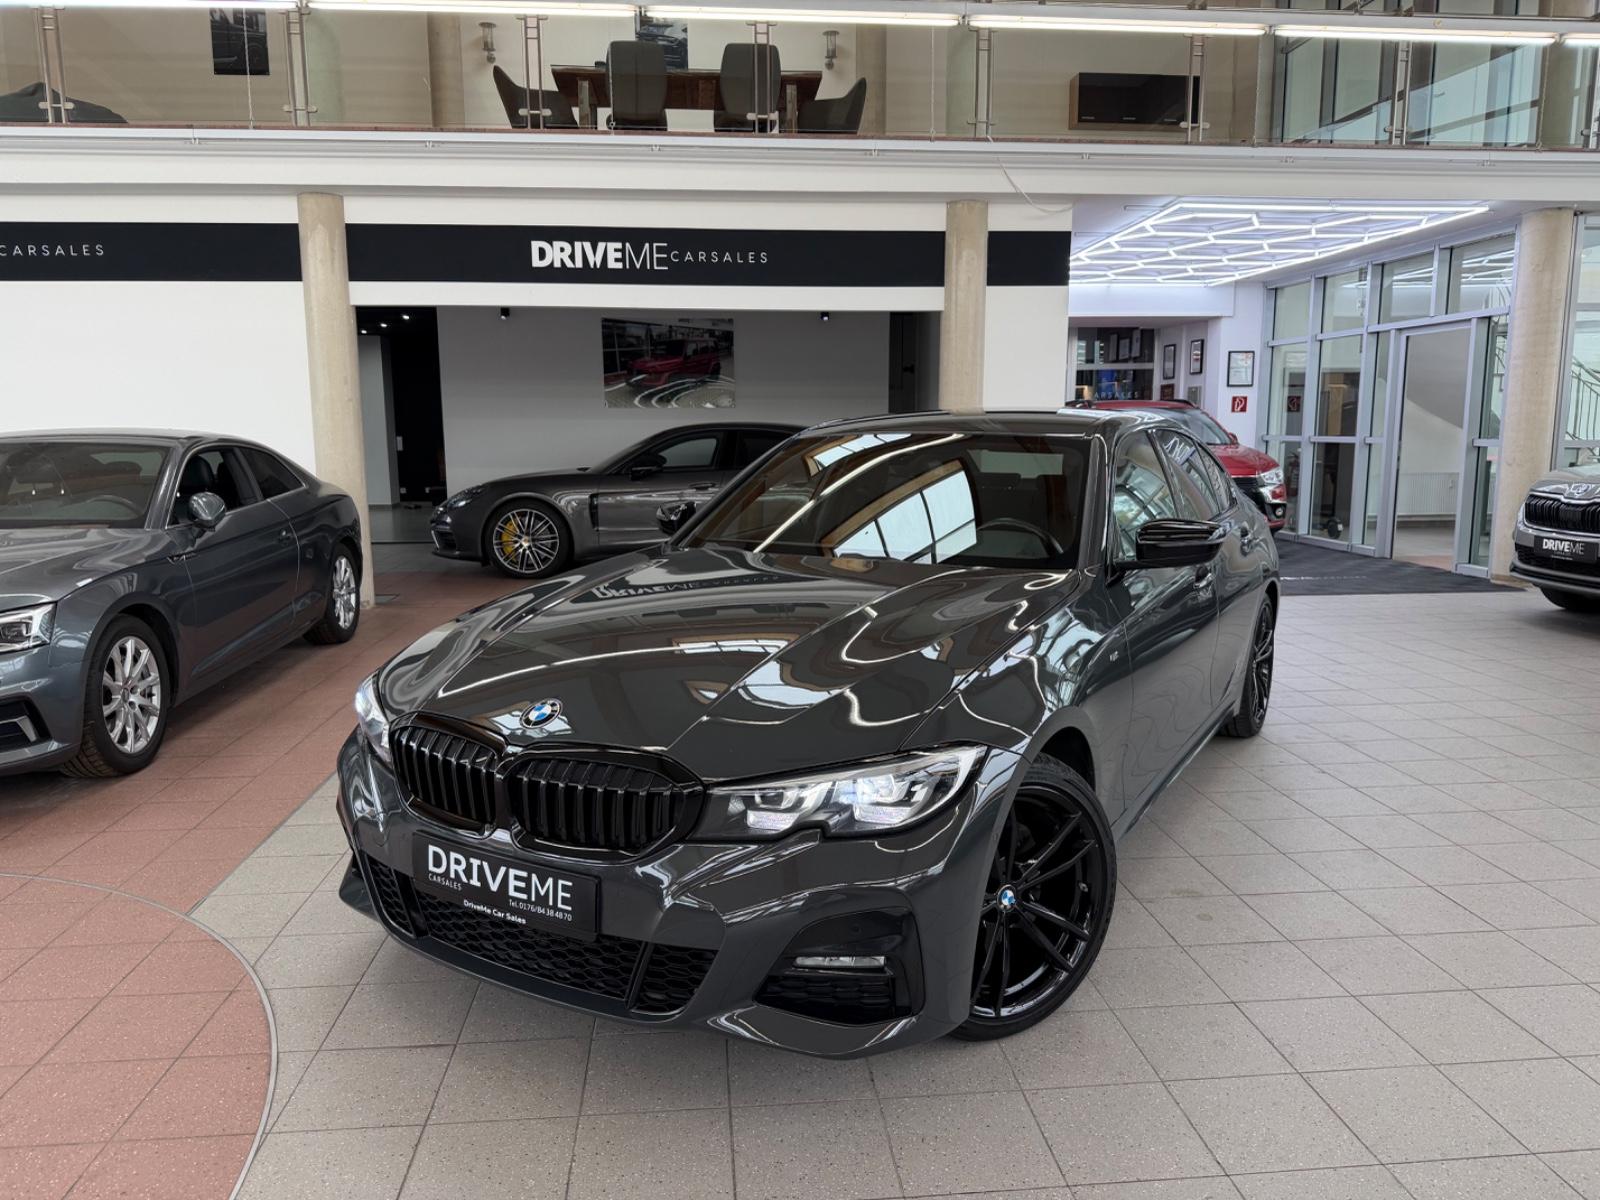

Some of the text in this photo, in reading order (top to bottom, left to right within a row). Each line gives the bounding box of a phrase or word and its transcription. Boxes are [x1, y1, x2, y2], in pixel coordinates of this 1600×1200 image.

[531, 240, 768, 270] DRIVEME CARSALES
[1542, 539, 1585, 555] DRIVEME
[428, 844, 572, 911] DRIVEME
[428, 873, 462, 891] CARSALES
[492, 908, 504, 918] Car
